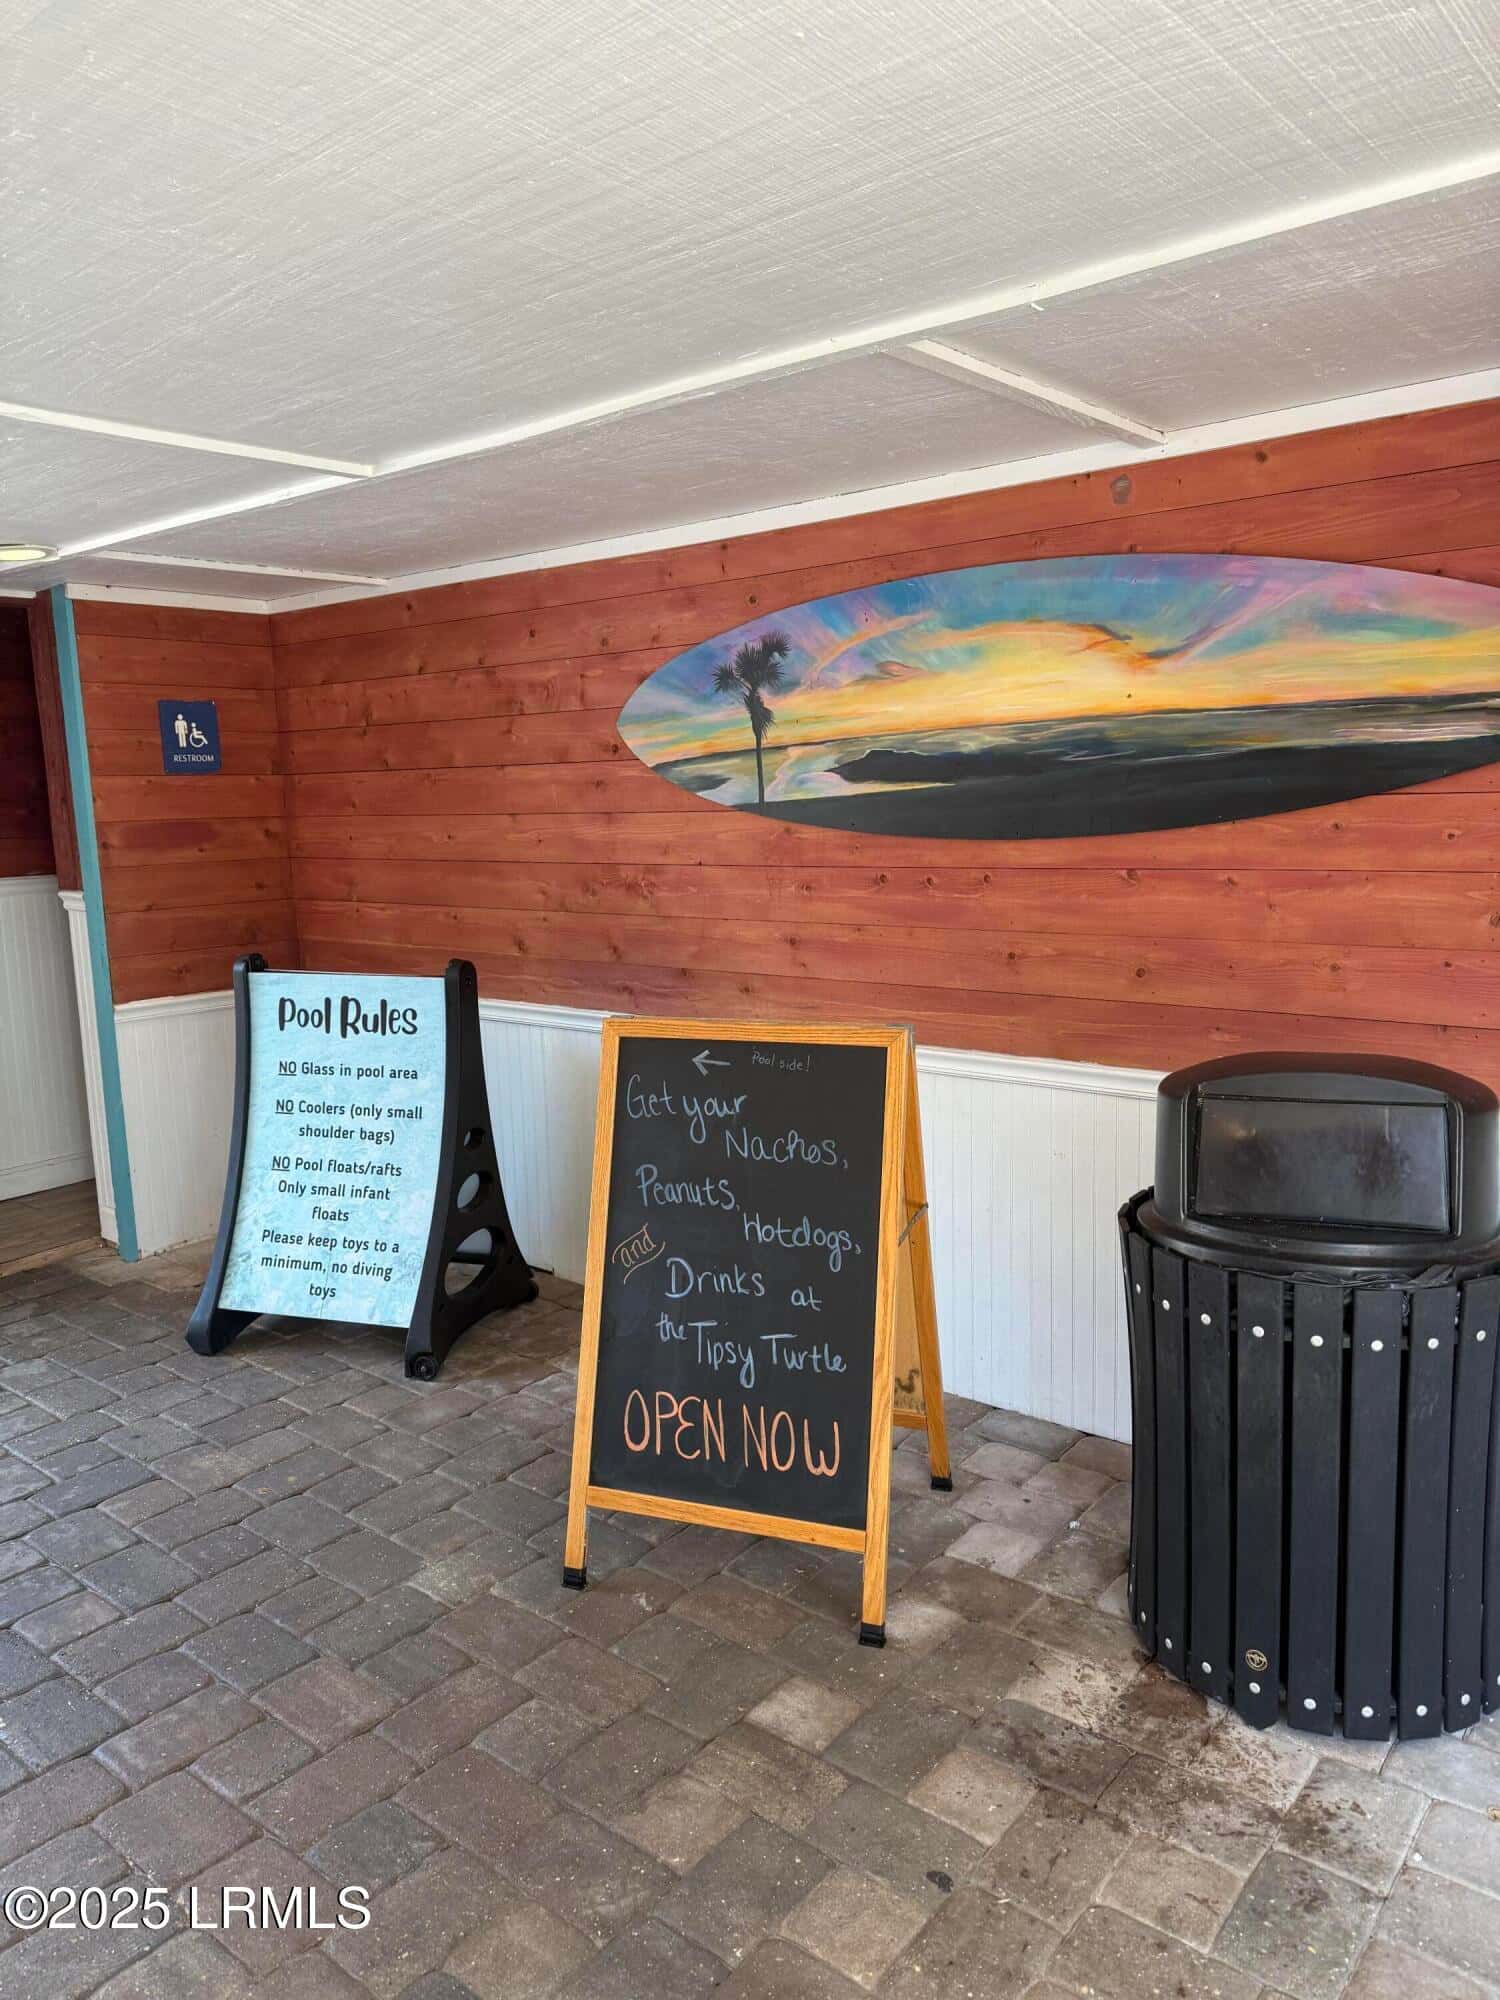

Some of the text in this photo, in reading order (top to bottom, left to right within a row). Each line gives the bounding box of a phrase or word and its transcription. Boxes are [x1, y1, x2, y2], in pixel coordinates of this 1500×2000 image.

[278, 996, 418, 1039] Pool Rules
[752, 1051, 775, 1067] Pool
[278, 1061, 418, 1080] NO Glass in pool area
[275, 1100, 423, 1120] NO Coolers (only small
[626, 1074, 748, 1144] Get your
[299, 1125, 395, 1145] shoulder bags)
[272, 1156, 402, 1177] NO Pool floats/rafts
[278, 1180, 390, 1201] Only small infant
[312, 1206, 350, 1222] floats
[262, 1229, 400, 1254] Please keep toys to a
[261, 1256, 393, 1281] minimum, no diving
[309, 1283, 336, 1299] toys
[664, 1257, 822, 1312] Drinks at
[656, 1312, 847, 1388] the Tipsy Turtle
[623, 1389, 840, 1478] OPEN NOW
